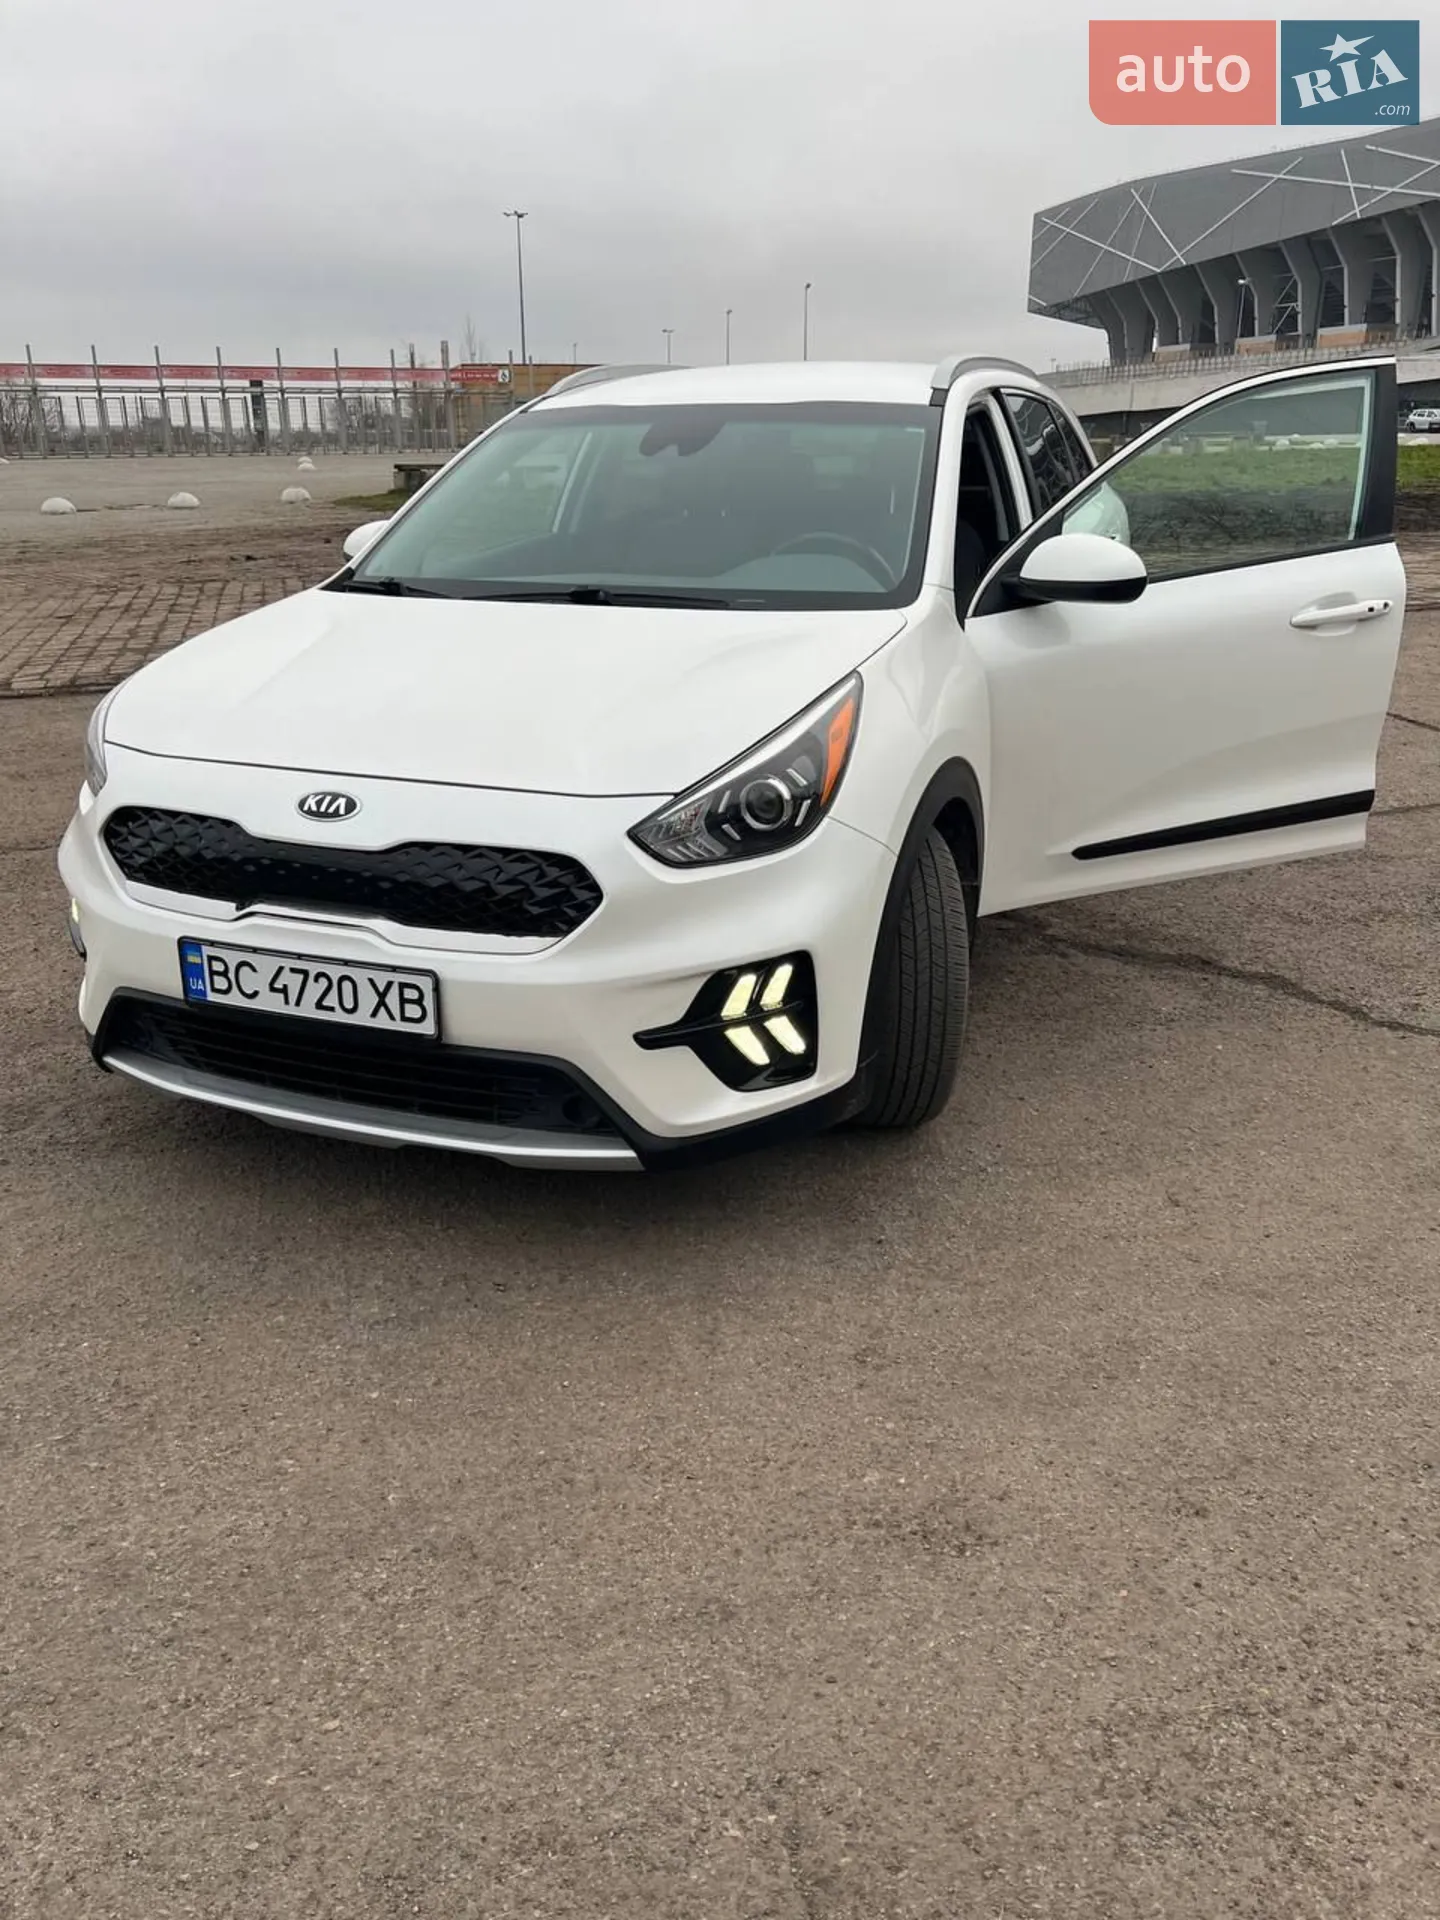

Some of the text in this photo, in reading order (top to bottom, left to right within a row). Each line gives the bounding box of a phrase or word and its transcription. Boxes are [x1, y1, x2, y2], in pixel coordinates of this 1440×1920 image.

[303, 794, 347, 815] KIA
[190, 977, 204, 991] UA
[206, 954, 428, 1024] BC 4720 XB
